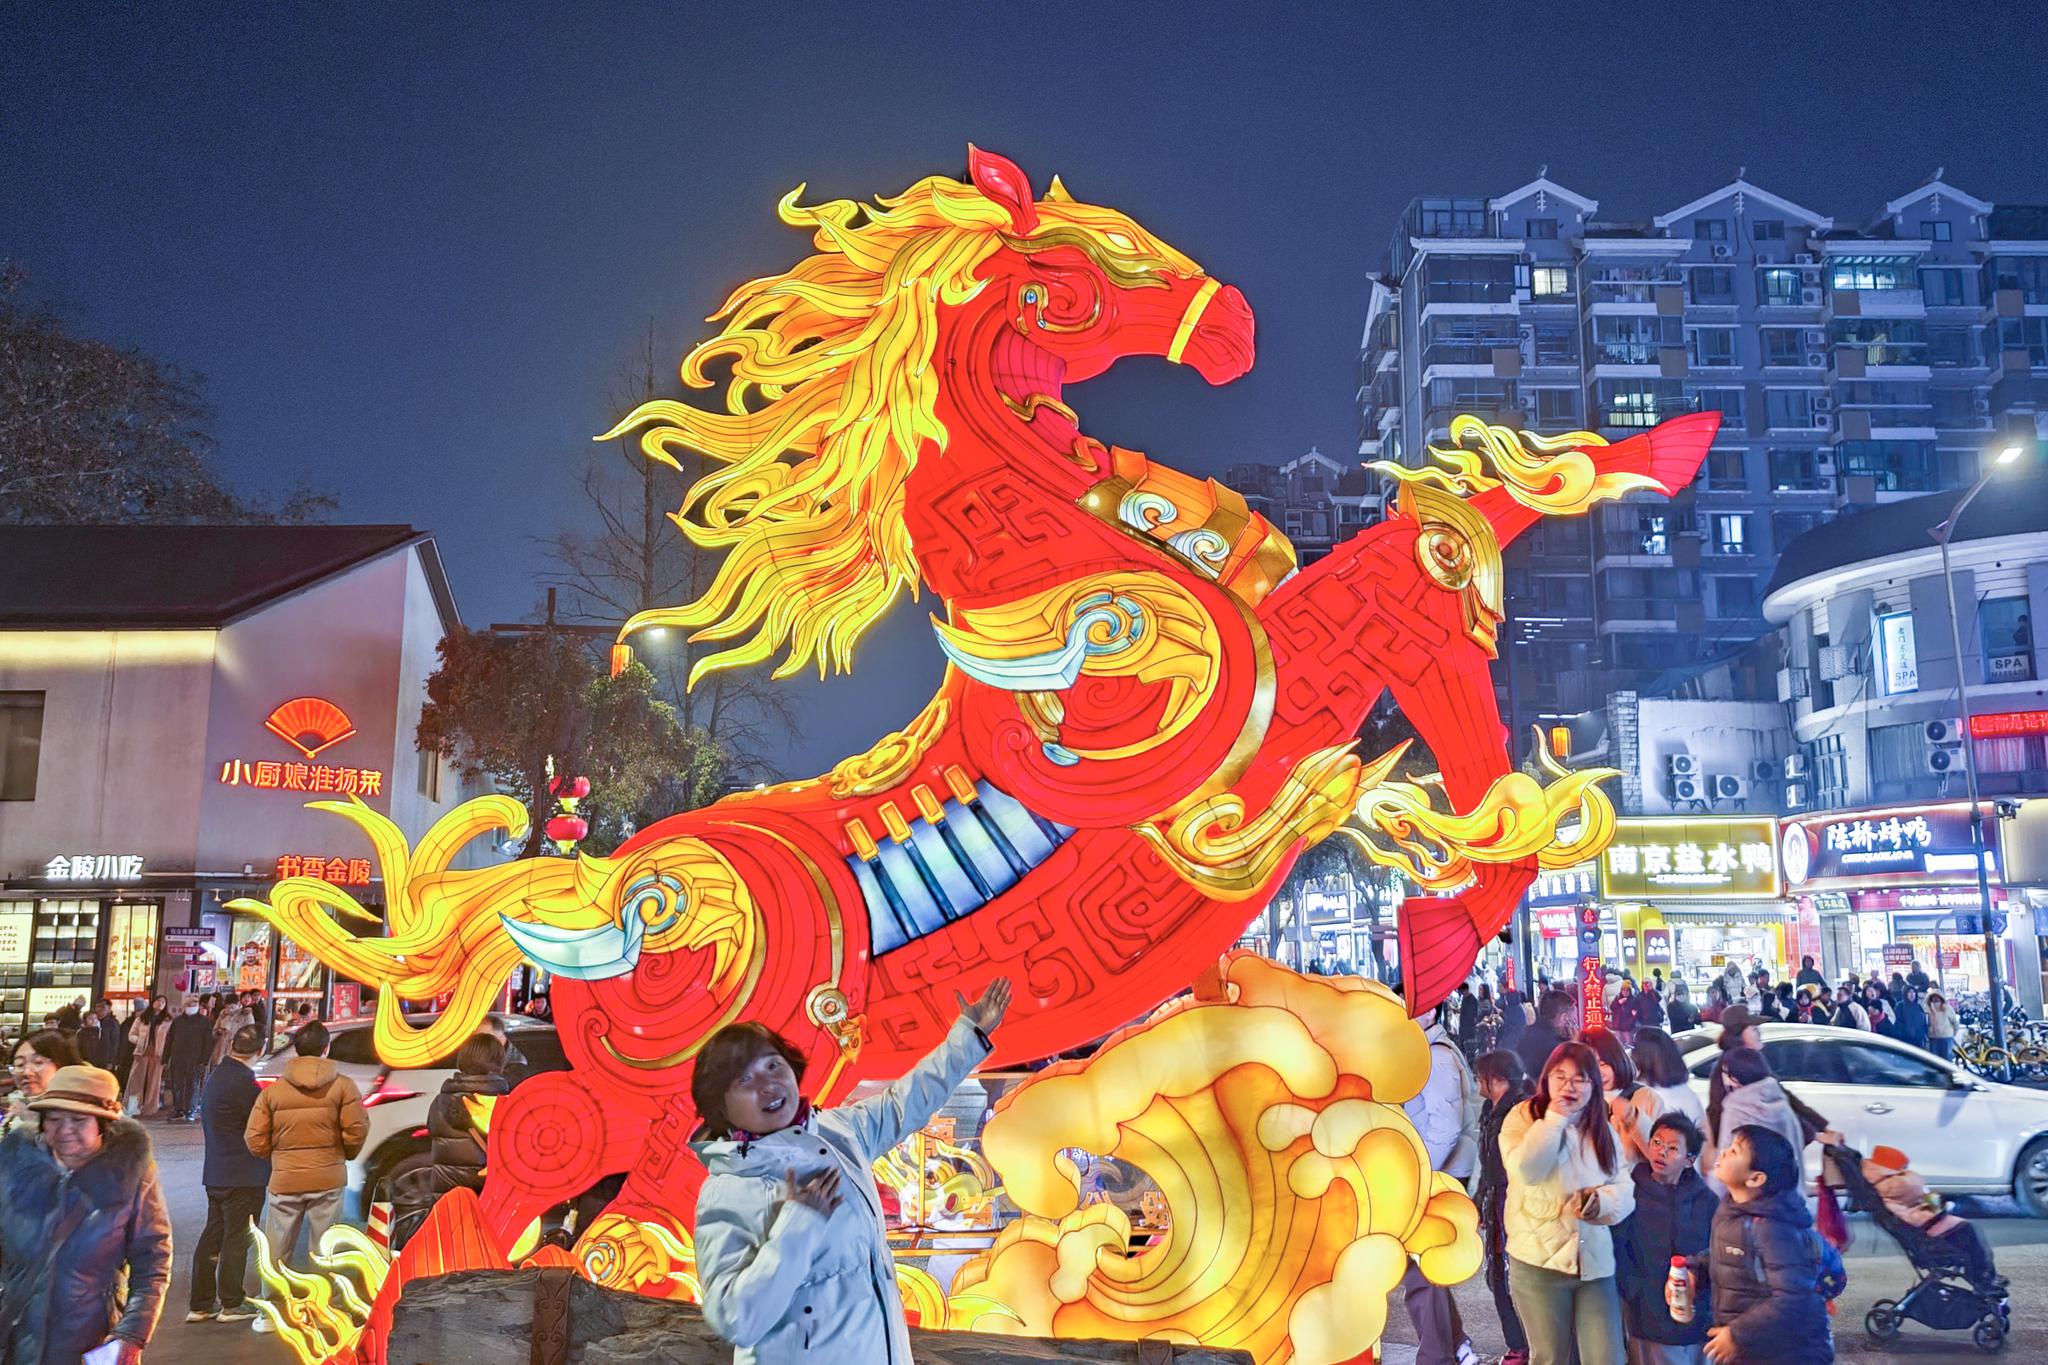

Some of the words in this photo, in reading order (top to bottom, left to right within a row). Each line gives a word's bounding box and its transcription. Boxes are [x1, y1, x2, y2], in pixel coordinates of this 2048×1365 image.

[1895, 670, 1917, 681] SPA
[1995, 658, 2023, 669] SPA
[221, 759, 383, 796] 小厨娘淮扬菜
[1827, 816, 1931, 851] 陈桥烤鸭
[46, 855, 144, 881] 金陵小吃
[277, 855, 371, 885] 书香金陵
[1607, 842, 1772, 875] 南京盐水鸭
[1583, 956, 1603, 1030] 行人禁止通
